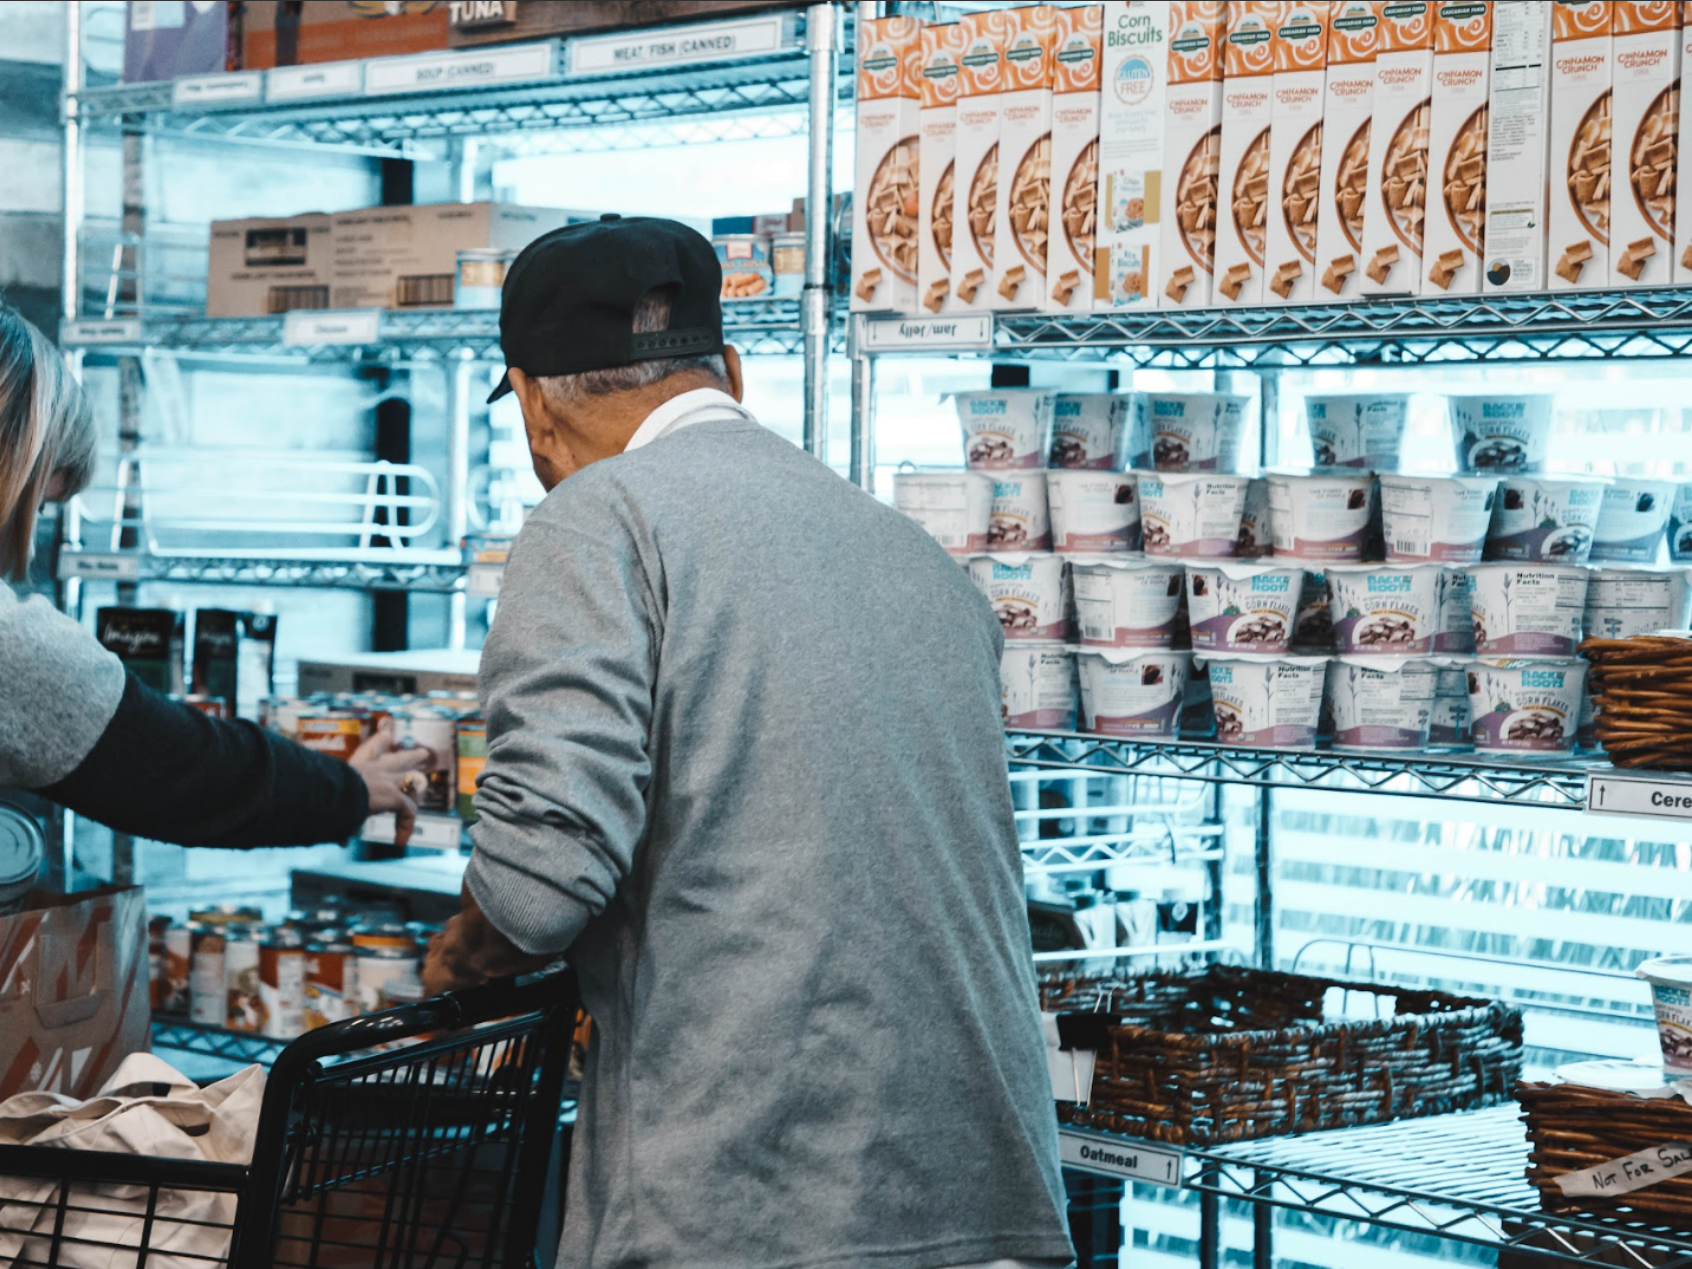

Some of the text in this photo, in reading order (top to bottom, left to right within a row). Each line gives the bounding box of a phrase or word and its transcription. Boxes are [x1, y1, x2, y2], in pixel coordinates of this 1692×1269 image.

[450, 1, 504, 23] TUNA
[1118, 14, 1151, 29] Corn
[1107, 26, 1163, 48] Biscuits
[650, 43, 675, 55] FISH
[1555, 55, 1605, 70] CINNAMON
[1617, 49, 1668, 64] CINNAMON
[1561, 64, 1598, 75] CRUNCH
[1623, 58, 1661, 70] CRUNCH
[1378, 67, 1422, 79] CINNAMON
[1436, 70, 1483, 82] CINNAMON
[1329, 79, 1374, 92] CINNAMON
[1383, 75, 1415, 85] CRUNCH
[1442, 78, 1476, 87] CRUNCH
[1120, 80, 1147, 95] FREE
[1275, 87, 1319, 99] CINNAMON
[1334, 87, 1367, 97] CRUNCH
[1226, 92, 1268, 104] CINNAMON
[993, 570, 1032, 580] ROOTS
[1251, 575, 1284, 584] BACK
[1366, 575, 1403, 584] BACK
[1516, 572, 1556, 580] Nutrition
[1251, 583, 1289, 593] ROOTS
[1366, 583, 1412, 593] ROOTS
[1516, 578, 1541, 586] Facts
[1245, 600, 1268, 610] CORN
[1269, 600, 1291, 616] FLAKES
[1364, 600, 1390, 611] CORN
[1390, 601, 1420, 617] FLAKES
[1277, 672, 1300, 680] Facts
[1360, 672, 1385, 680] Facts
[1521, 669, 1555, 679] BACK
[1521, 678, 1564, 689] ROOTS
[1516, 696, 1540, 707] CORN
[1541, 696, 1570, 712] FLAKES
[1079, 1144, 1138, 1169] Oatmeal
[1622, 1160, 1655, 1181] FOR
